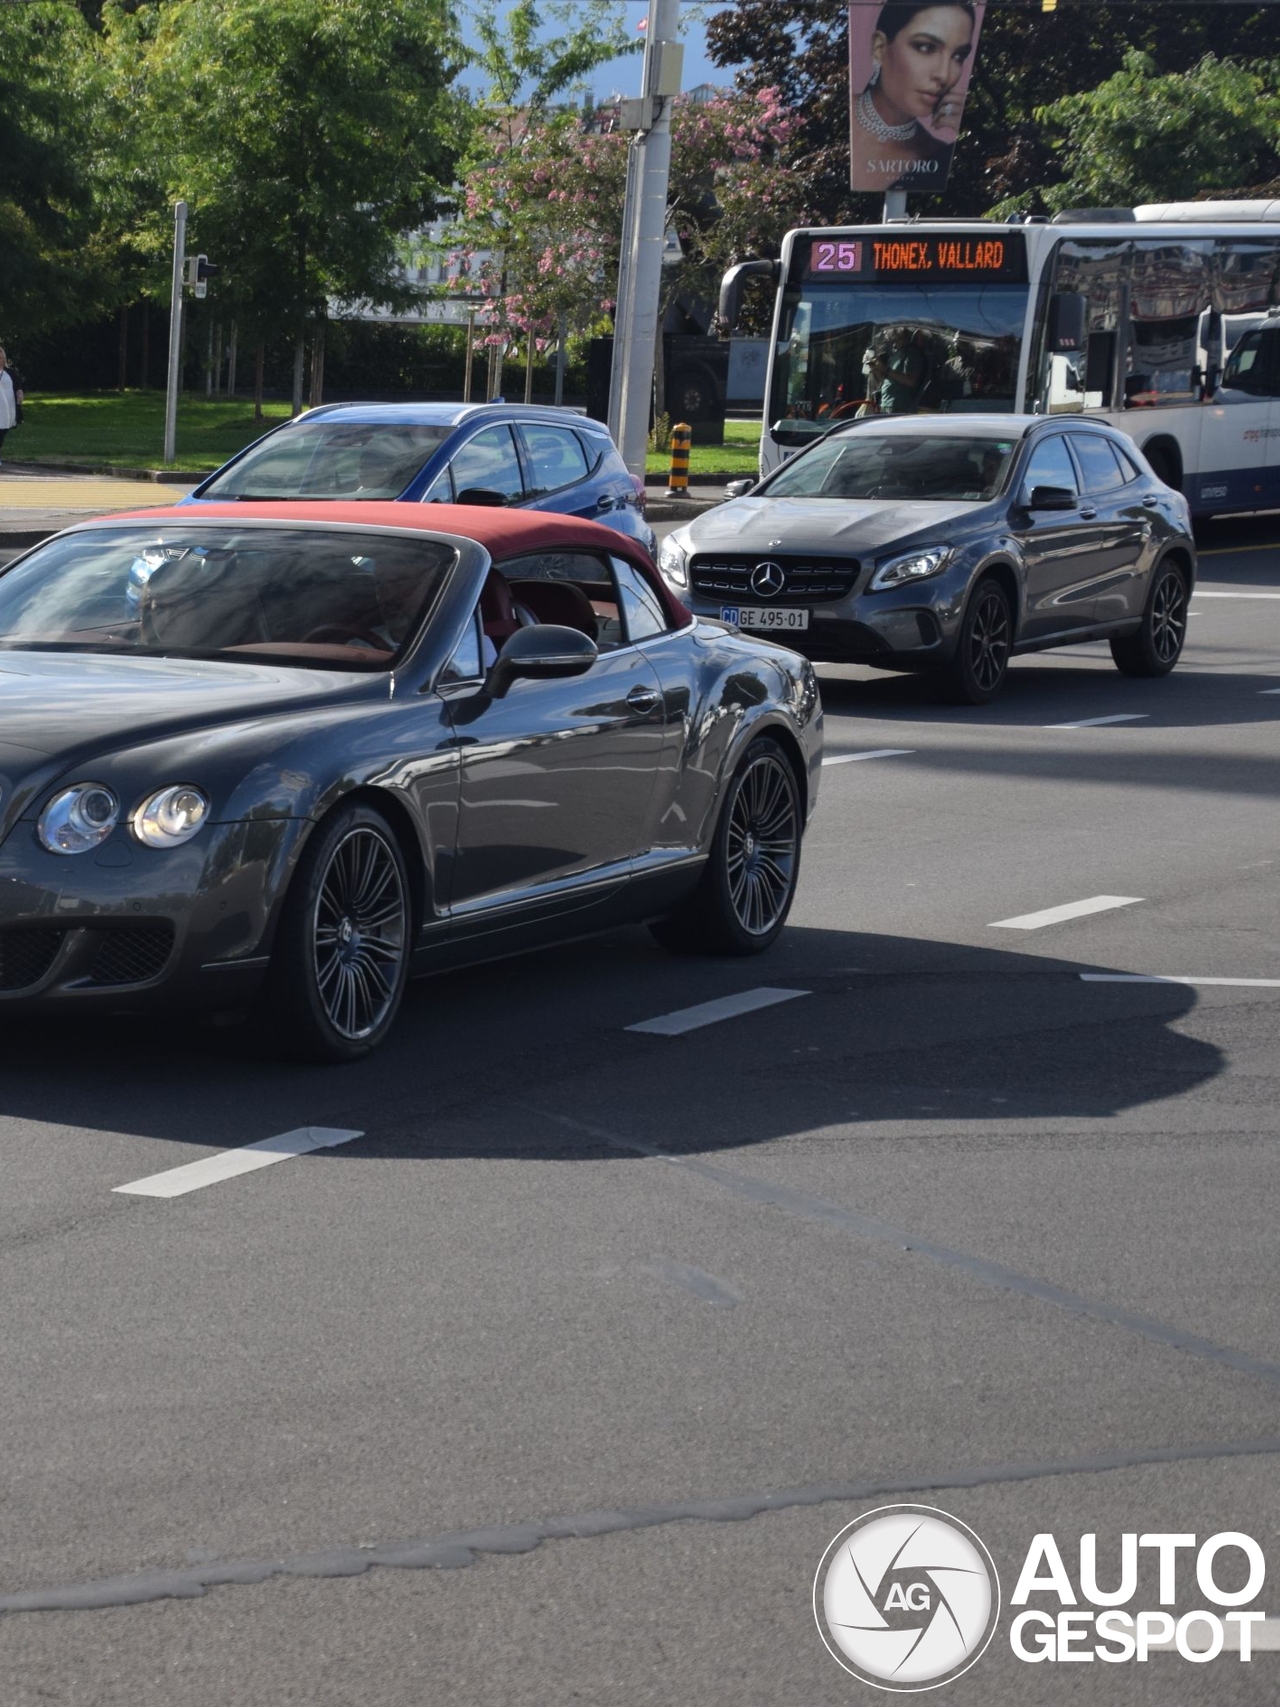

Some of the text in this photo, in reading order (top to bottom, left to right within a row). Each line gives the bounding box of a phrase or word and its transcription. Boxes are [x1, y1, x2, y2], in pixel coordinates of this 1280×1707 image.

[866, 159, 939, 173] SARTORO
[817, 241, 1004, 270] 25 THONEX, VALLARD
[740, 610, 755, 625] GE
